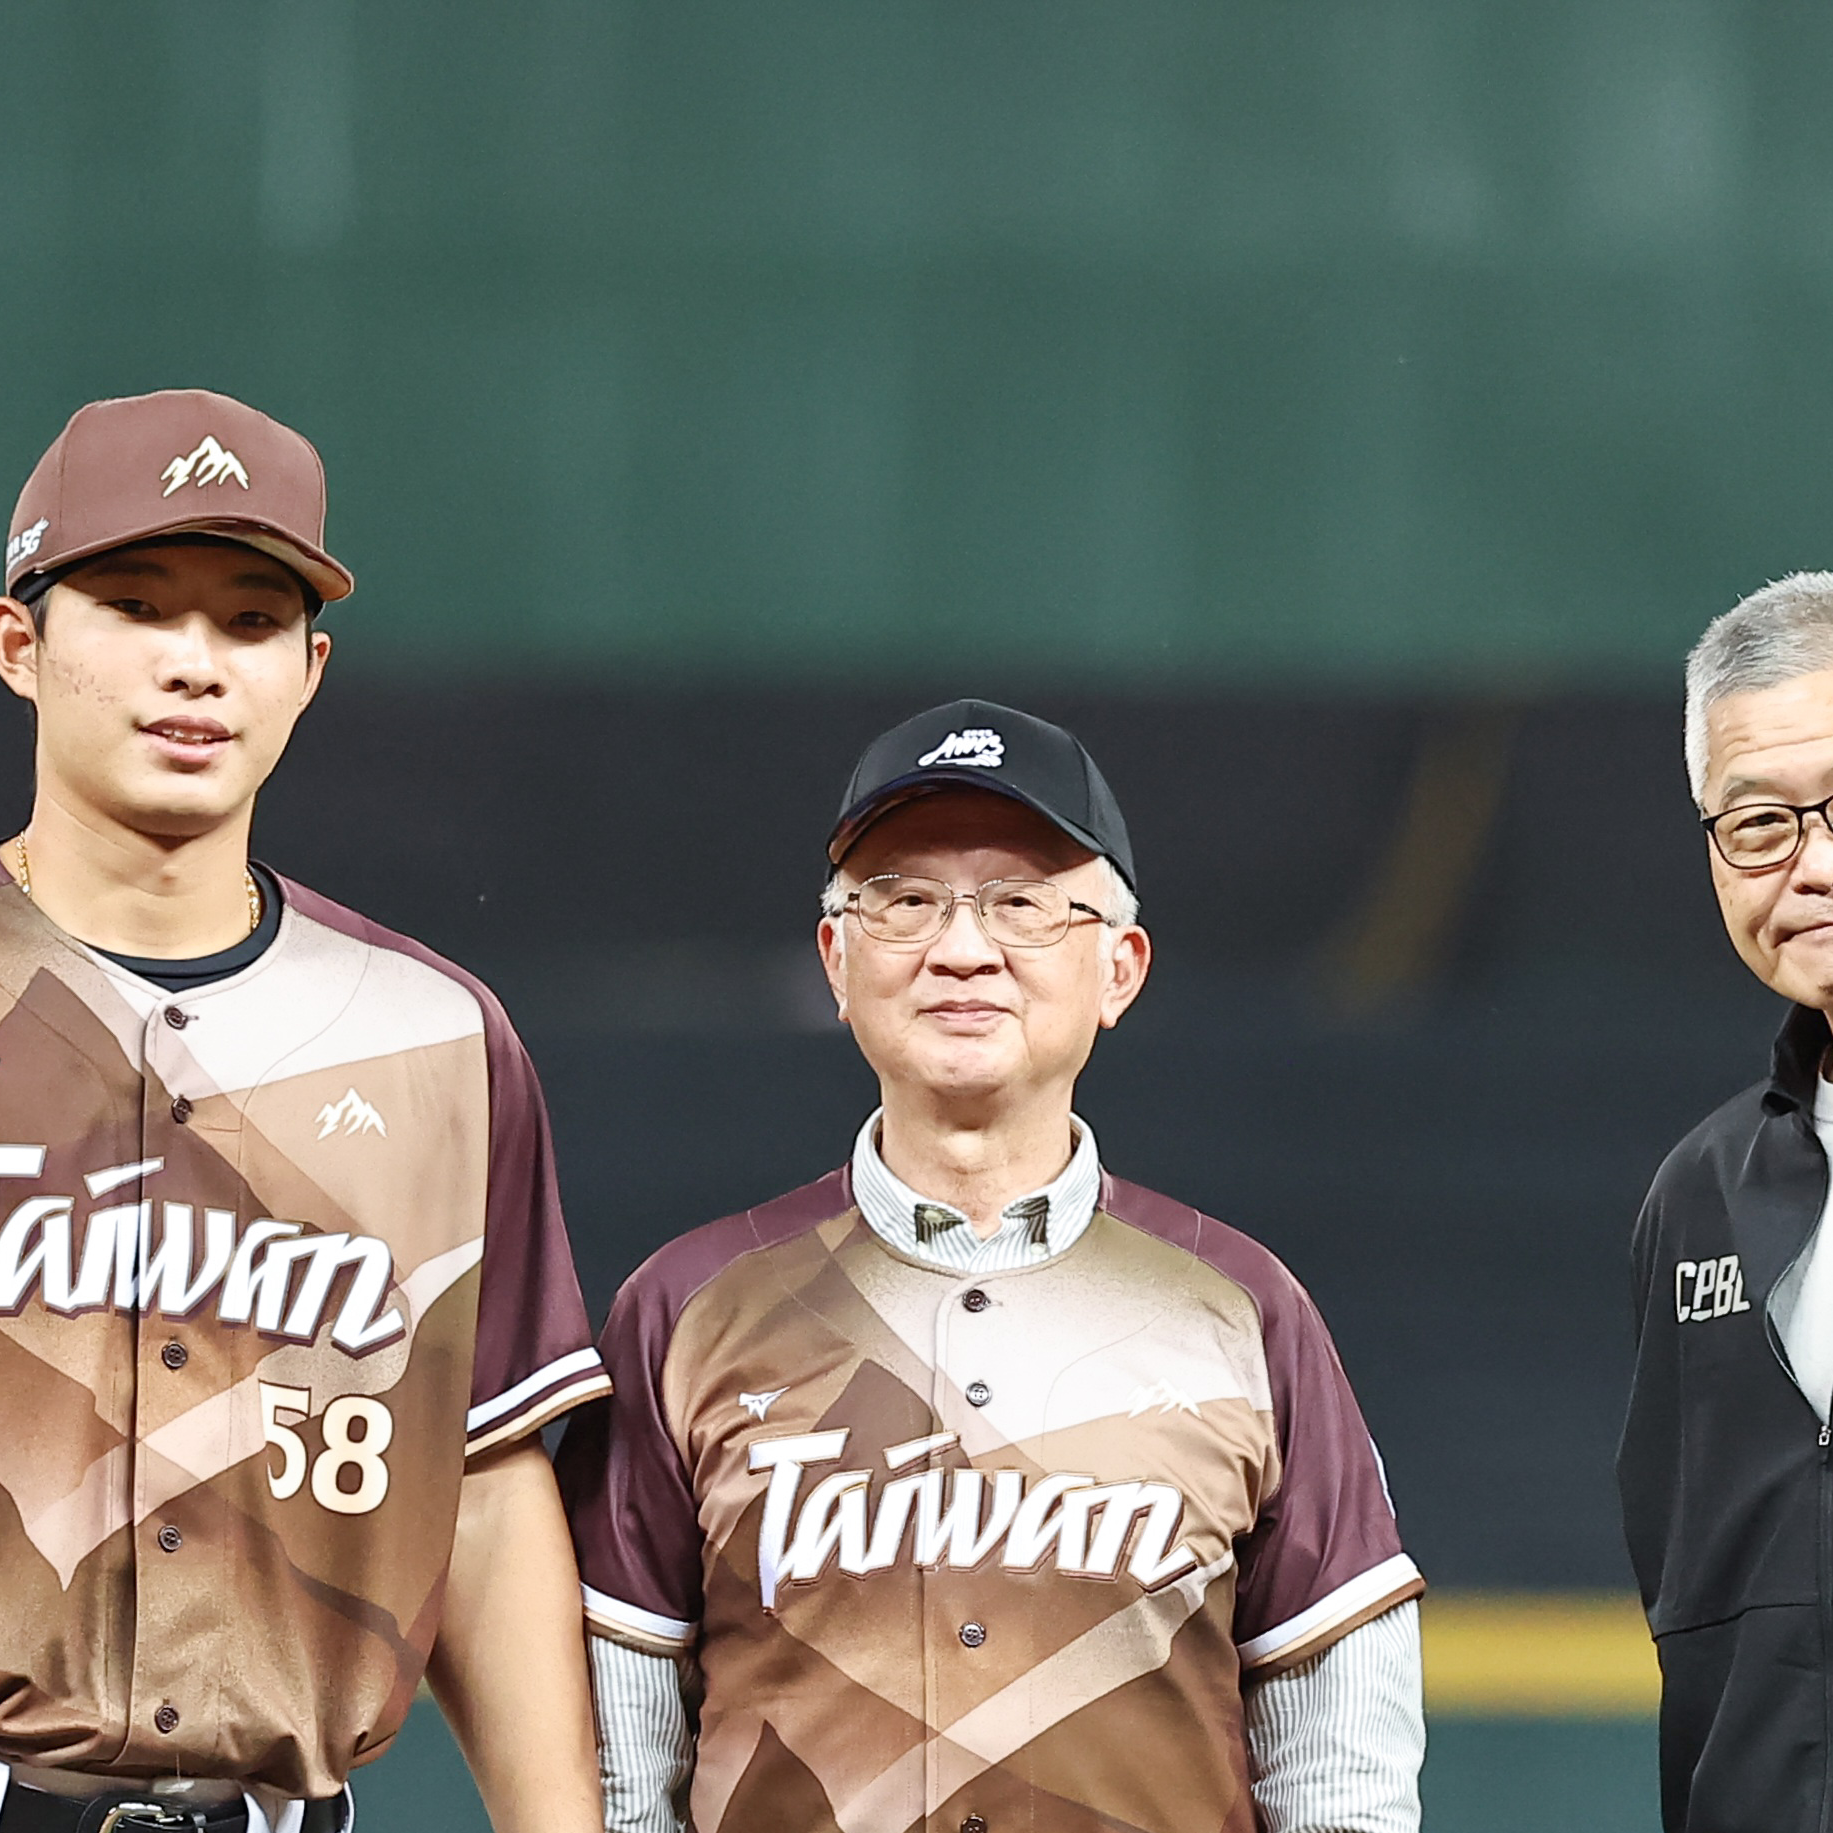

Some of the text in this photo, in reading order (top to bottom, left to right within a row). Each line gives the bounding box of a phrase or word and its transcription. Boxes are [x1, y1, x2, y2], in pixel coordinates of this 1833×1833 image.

[1675, 1254, 1751, 1324] CPBL
[258, 1379, 394, 1515] 58
[747, 1427, 1198, 1615] Taiwan
